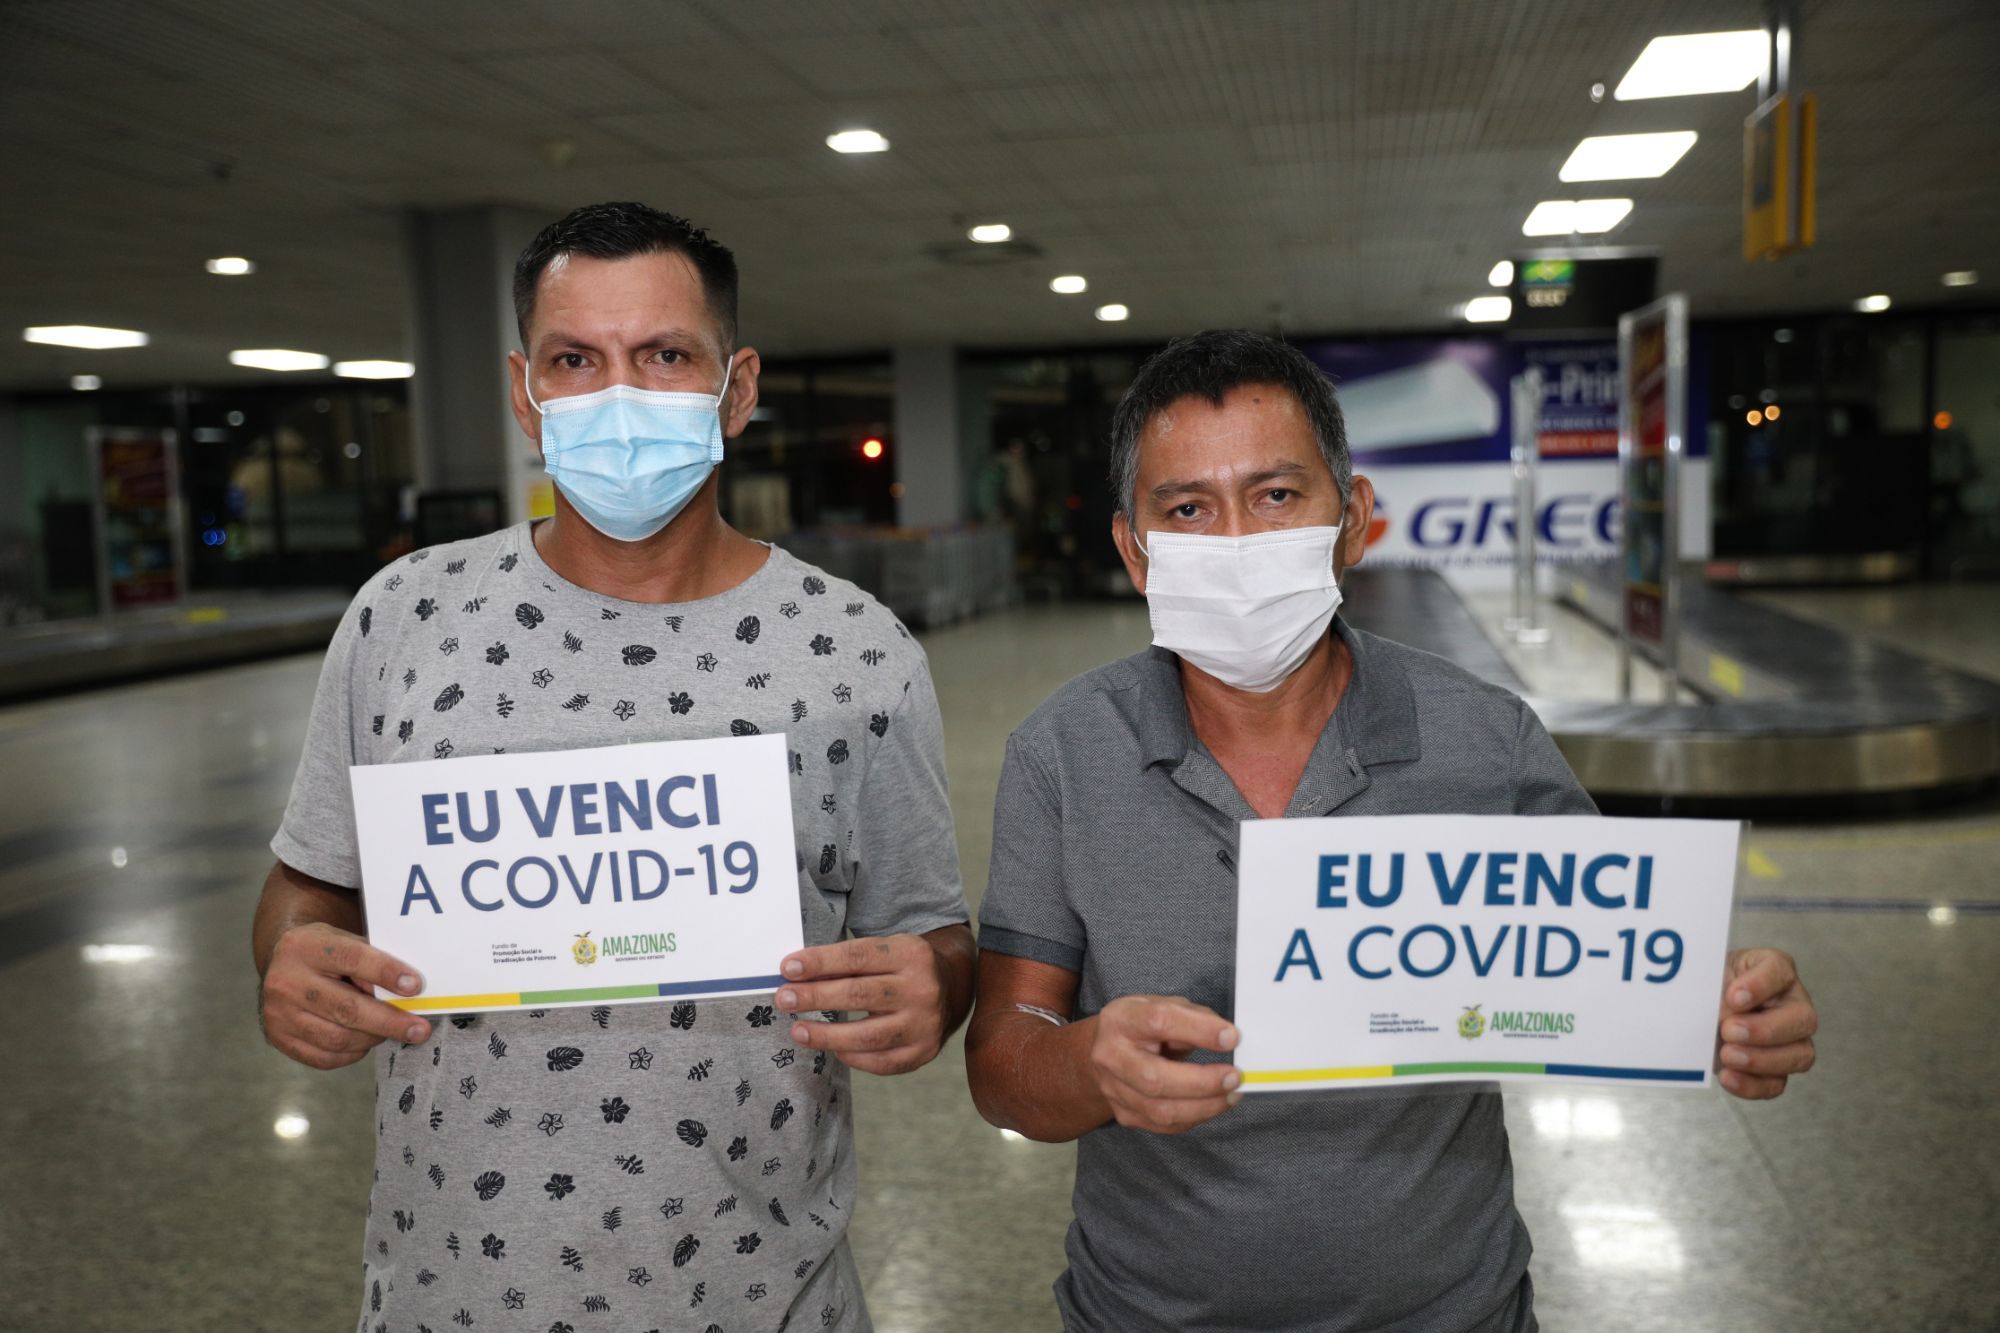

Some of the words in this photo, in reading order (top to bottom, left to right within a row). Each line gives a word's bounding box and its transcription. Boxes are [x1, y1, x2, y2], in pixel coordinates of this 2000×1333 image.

[422, 790, 501, 846] EU
[516, 774, 721, 839] VENCI
[400, 864, 444, 917] A
[461, 841, 759, 911] COVID-19
[1316, 853, 1406, 910] EU
[1426, 852, 1654, 911] VENCI
[602, 932, 677, 956] AMAZONAS
[1274, 928, 1323, 983] A
[1347, 924, 1685, 985] COVID-19
[1490, 1011, 1575, 1034] AMAZONAS
